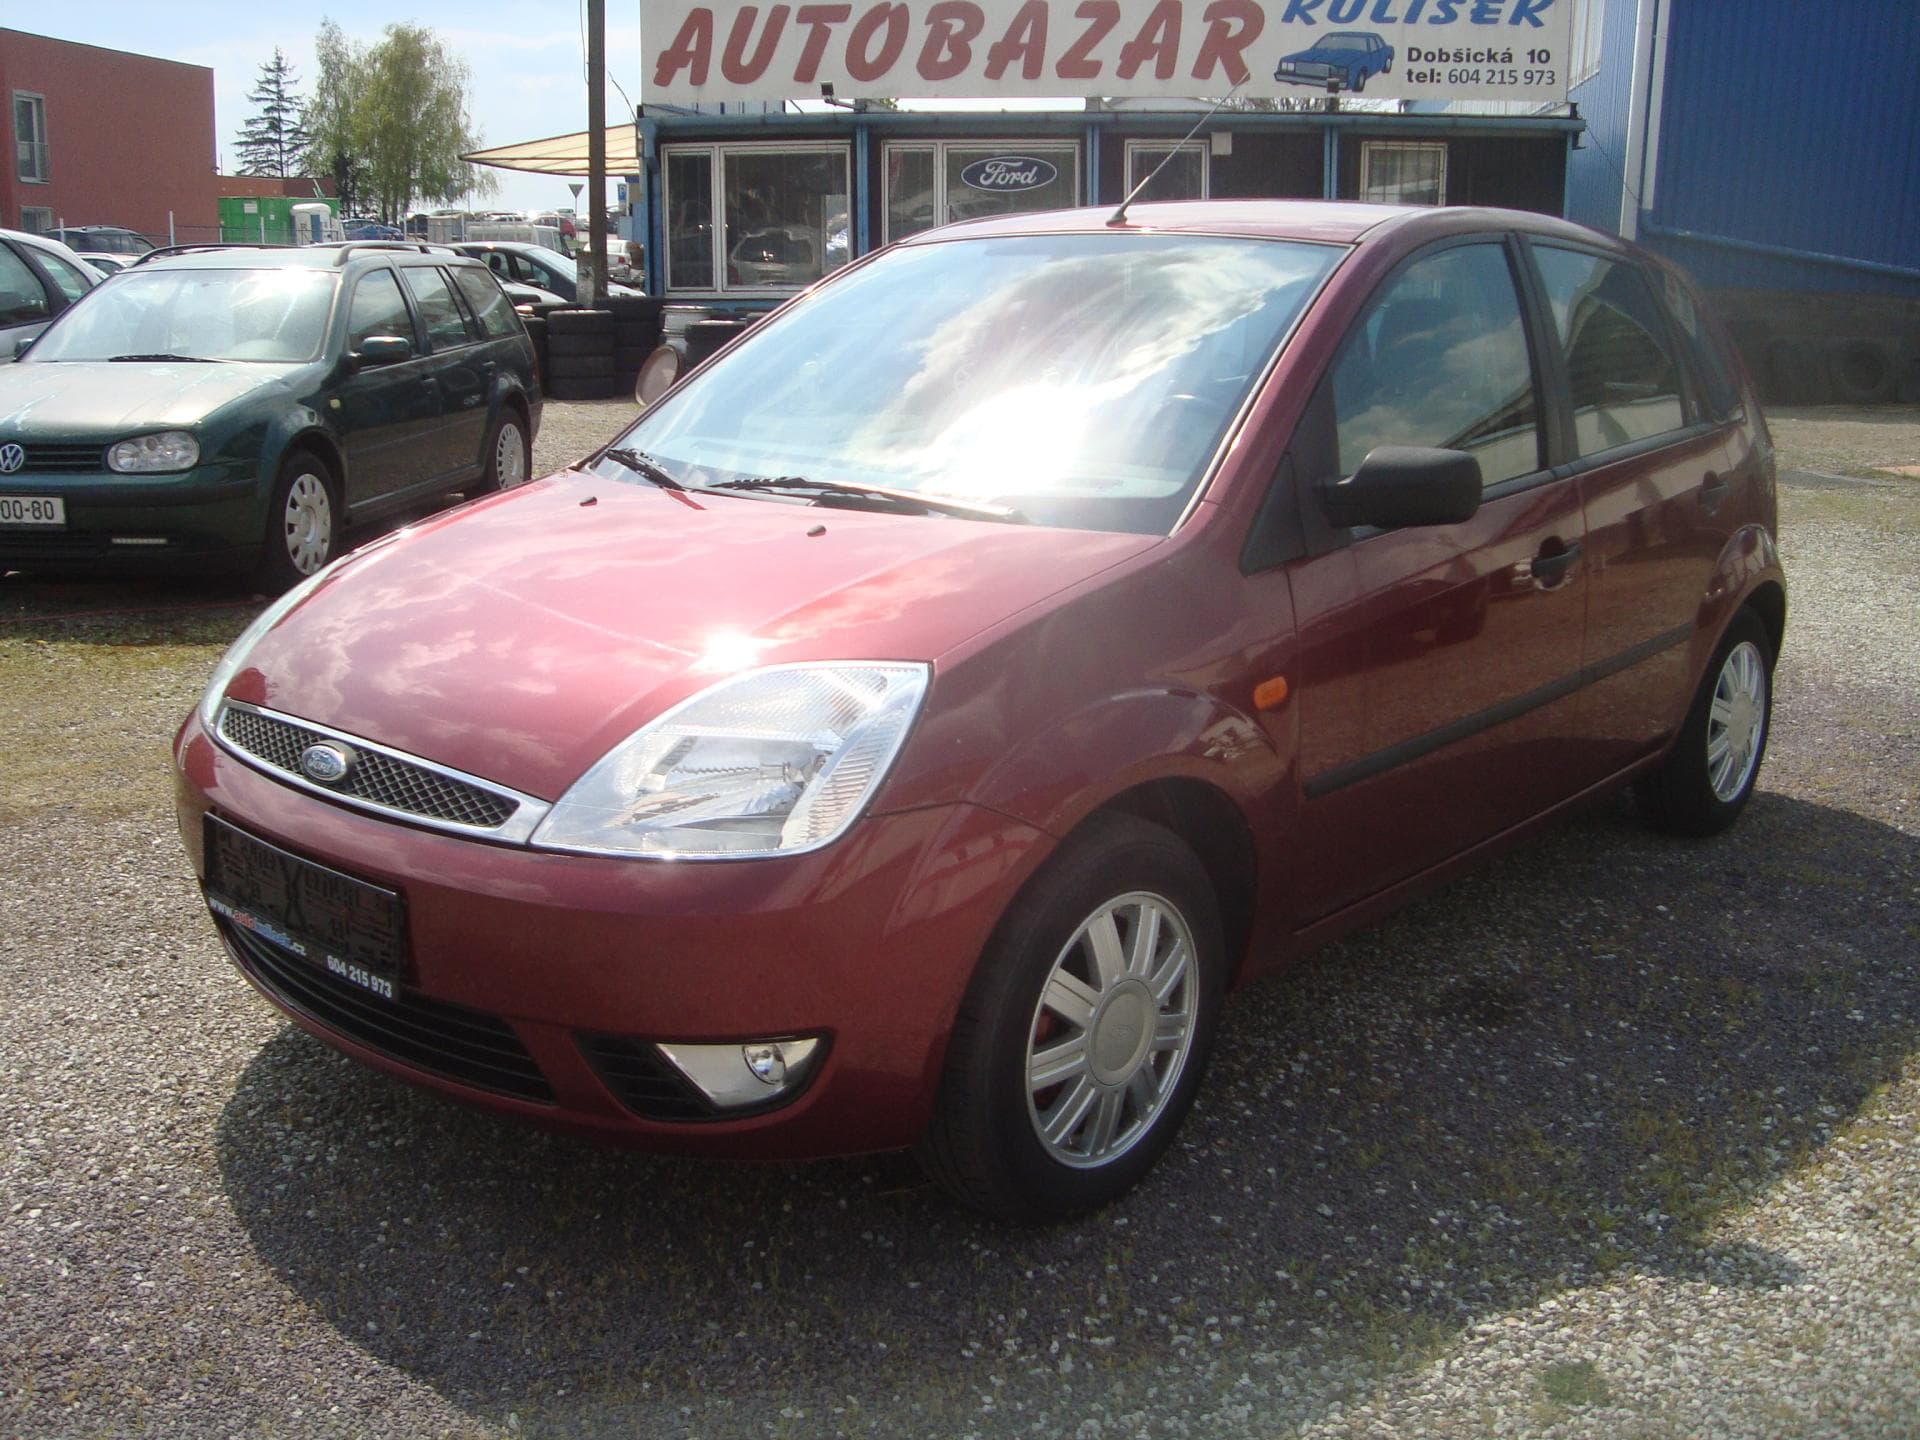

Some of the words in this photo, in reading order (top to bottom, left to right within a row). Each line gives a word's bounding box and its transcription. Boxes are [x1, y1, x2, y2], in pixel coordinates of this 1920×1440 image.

[653, 0, 1265, 87] AUTOBAZAR
[1407, 47, 1513, 64] Dobšická
[1527, 49, 1551, 64] 10
[1407, 68, 1441, 84] tel:
[1448, 68, 1480, 84] 604
[1486, 69, 1518, 85] 215
[1523, 69, 1556, 86] 973
[980, 161, 1038, 185] Ford
[327, 954, 347, 976] 604
[349, 965, 369, 988] 215
[370, 975, 392, 998] 973
